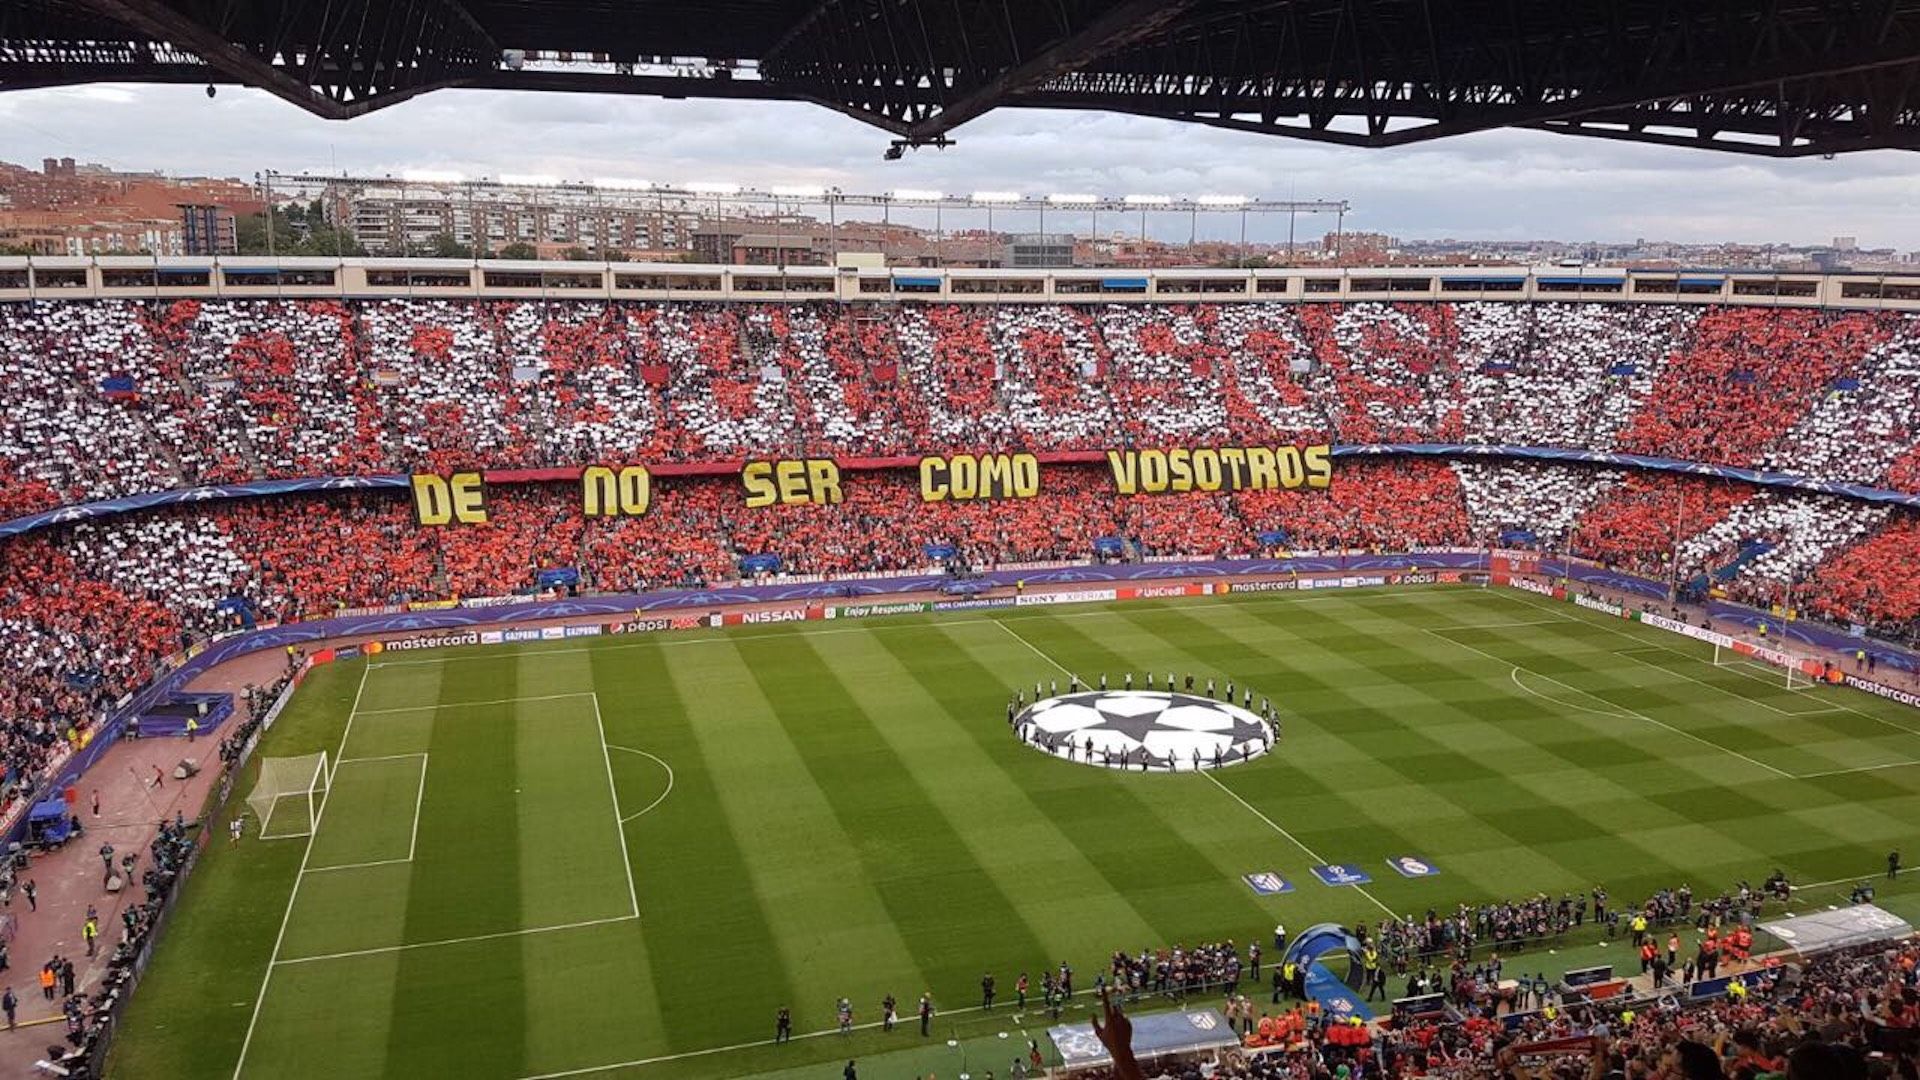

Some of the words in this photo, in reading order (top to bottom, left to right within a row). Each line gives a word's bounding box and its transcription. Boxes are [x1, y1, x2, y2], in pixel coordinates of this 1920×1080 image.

[411, 472, 488, 525] DE
[584, 466, 650, 516] NO
[742, 459, 844, 507] SER
[919, 453, 1039, 501] COMO
[1108, 445, 1332, 494] VOSOTROS
[1232, 580, 1296, 593] mastercard
[1404, 573, 1436, 585] pepsi
[1509, 577, 1554, 597] NISSAN
[1020, 594, 1057, 605] SONY
[1575, 593, 1623, 617] Heineken
[743, 609, 806, 624] NISSAN
[844, 605, 870, 618] Enjoy
[871, 602, 925, 615] Responsibly
[627, 618, 668, 634] pepsi
[1651, 615, 1687, 632] SONY
[386, 631, 478, 651] mastercard
